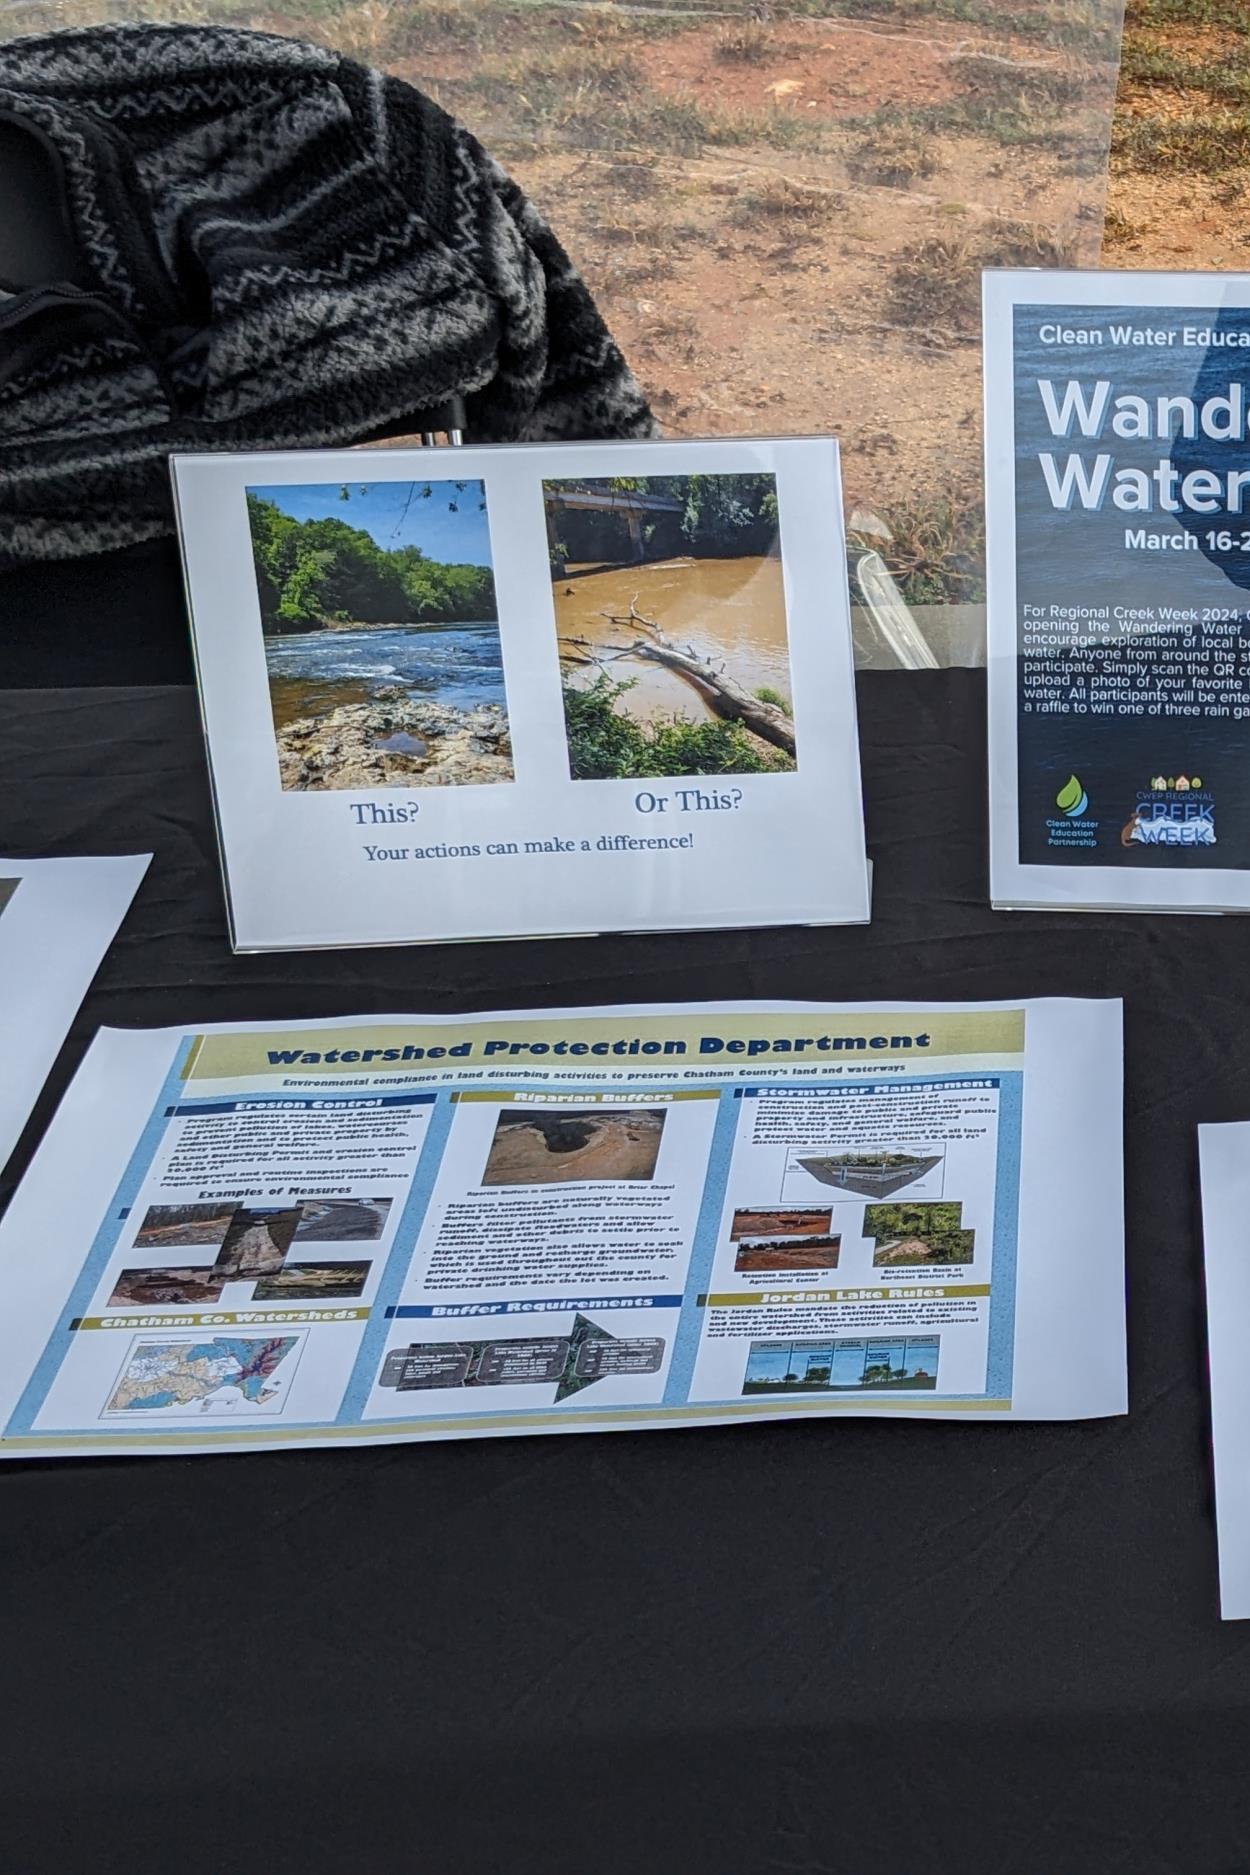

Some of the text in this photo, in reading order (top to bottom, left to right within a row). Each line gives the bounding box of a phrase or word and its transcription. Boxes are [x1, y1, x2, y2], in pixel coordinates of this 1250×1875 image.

[1039, 325, 1103, 345] Clean
[1110, 326, 1176, 346] Water
[1125, 529, 1198, 551] March
[1023, 605, 1046, 616] For
[1050, 605, 1108, 620] Regional
[1113, 606, 1154, 619] Creek
[1158, 607, 1198, 619] Week
[1202, 608, 1242, 622] 2024,
[1023, 619, 1079, 633] opening
[1088, 620, 1109, 631] the
[1119, 620, 1192, 636] Wandering
[1202, 622, 1242, 634] Water
[1024, 635, 1096, 647] encourage
[1102, 634, 1176, 649] exploration
[1183, 635, 1196, 647] of
[1201, 636, 1232, 648] local
[1023, 646, 1064, 658] water.
[1069, 647, 1121, 661] Anyone
[1126, 648, 1156, 660] from
[1162, 648, 1209, 661] around
[1214, 650, 1235, 661] the
[1024, 660, 1098, 675] participate.
[1102, 661, 1146, 676] Simply
[1152, 664, 1182, 674] scan
[1187, 663, 1208, 674] the
[1213, 663, 1234, 675] QR
[1024, 673, 1070, 688] upload
[1076, 676, 1084, 685] a
[1091, 674, 1129, 689] photo
[1136, 675, 1149, 687] of
[1155, 678, 1185, 690] your
[1192, 676, 1242, 689] favorite
[1024, 687, 1064, 698] water.
[1069, 687, 1085, 699] All
[1090, 688, 1167, 703] participants
[1172, 689, 1193, 701] will
[1198, 690, 1215, 702] be
[1024, 702, 1031, 711] a
[1036, 700, 1069, 712] raffle
[1074, 702, 1087, 712] to
[1090, 702, 1113, 713] win
[1118, 704, 1143, 714] one
[1148, 702, 1161, 714] of
[1165, 703, 1200, 715] three
[1204, 704, 1229, 715] rain
[635, 788, 743, 814] Or This?
[1136, 792, 1214, 801] CWEP REGIONAL
[350, 802, 420, 825] This?
[1136, 803, 1215, 822] CREEK
[1048, 839, 1097, 847] Partnership
[1139, 824, 1212, 846] WEEK
[363, 833, 694, 862] Your actions can make a difference!
[268, 1032, 931, 1065] Watershed Protection Department
[757, 1079, 993, 1098] Stormwater Management
[235, 1098, 384, 1112] Erosion Control
[514, 1092, 674, 1103] Riparian Buffers
[198, 1185, 353, 1200] Examples of Measures
[760, 1288, 945, 1304] Jordan Lake Rules
[432, 1297, 654, 1317] Buffer Requirements
[100, 1308, 358, 1328] Chatham Co. Watersheds
